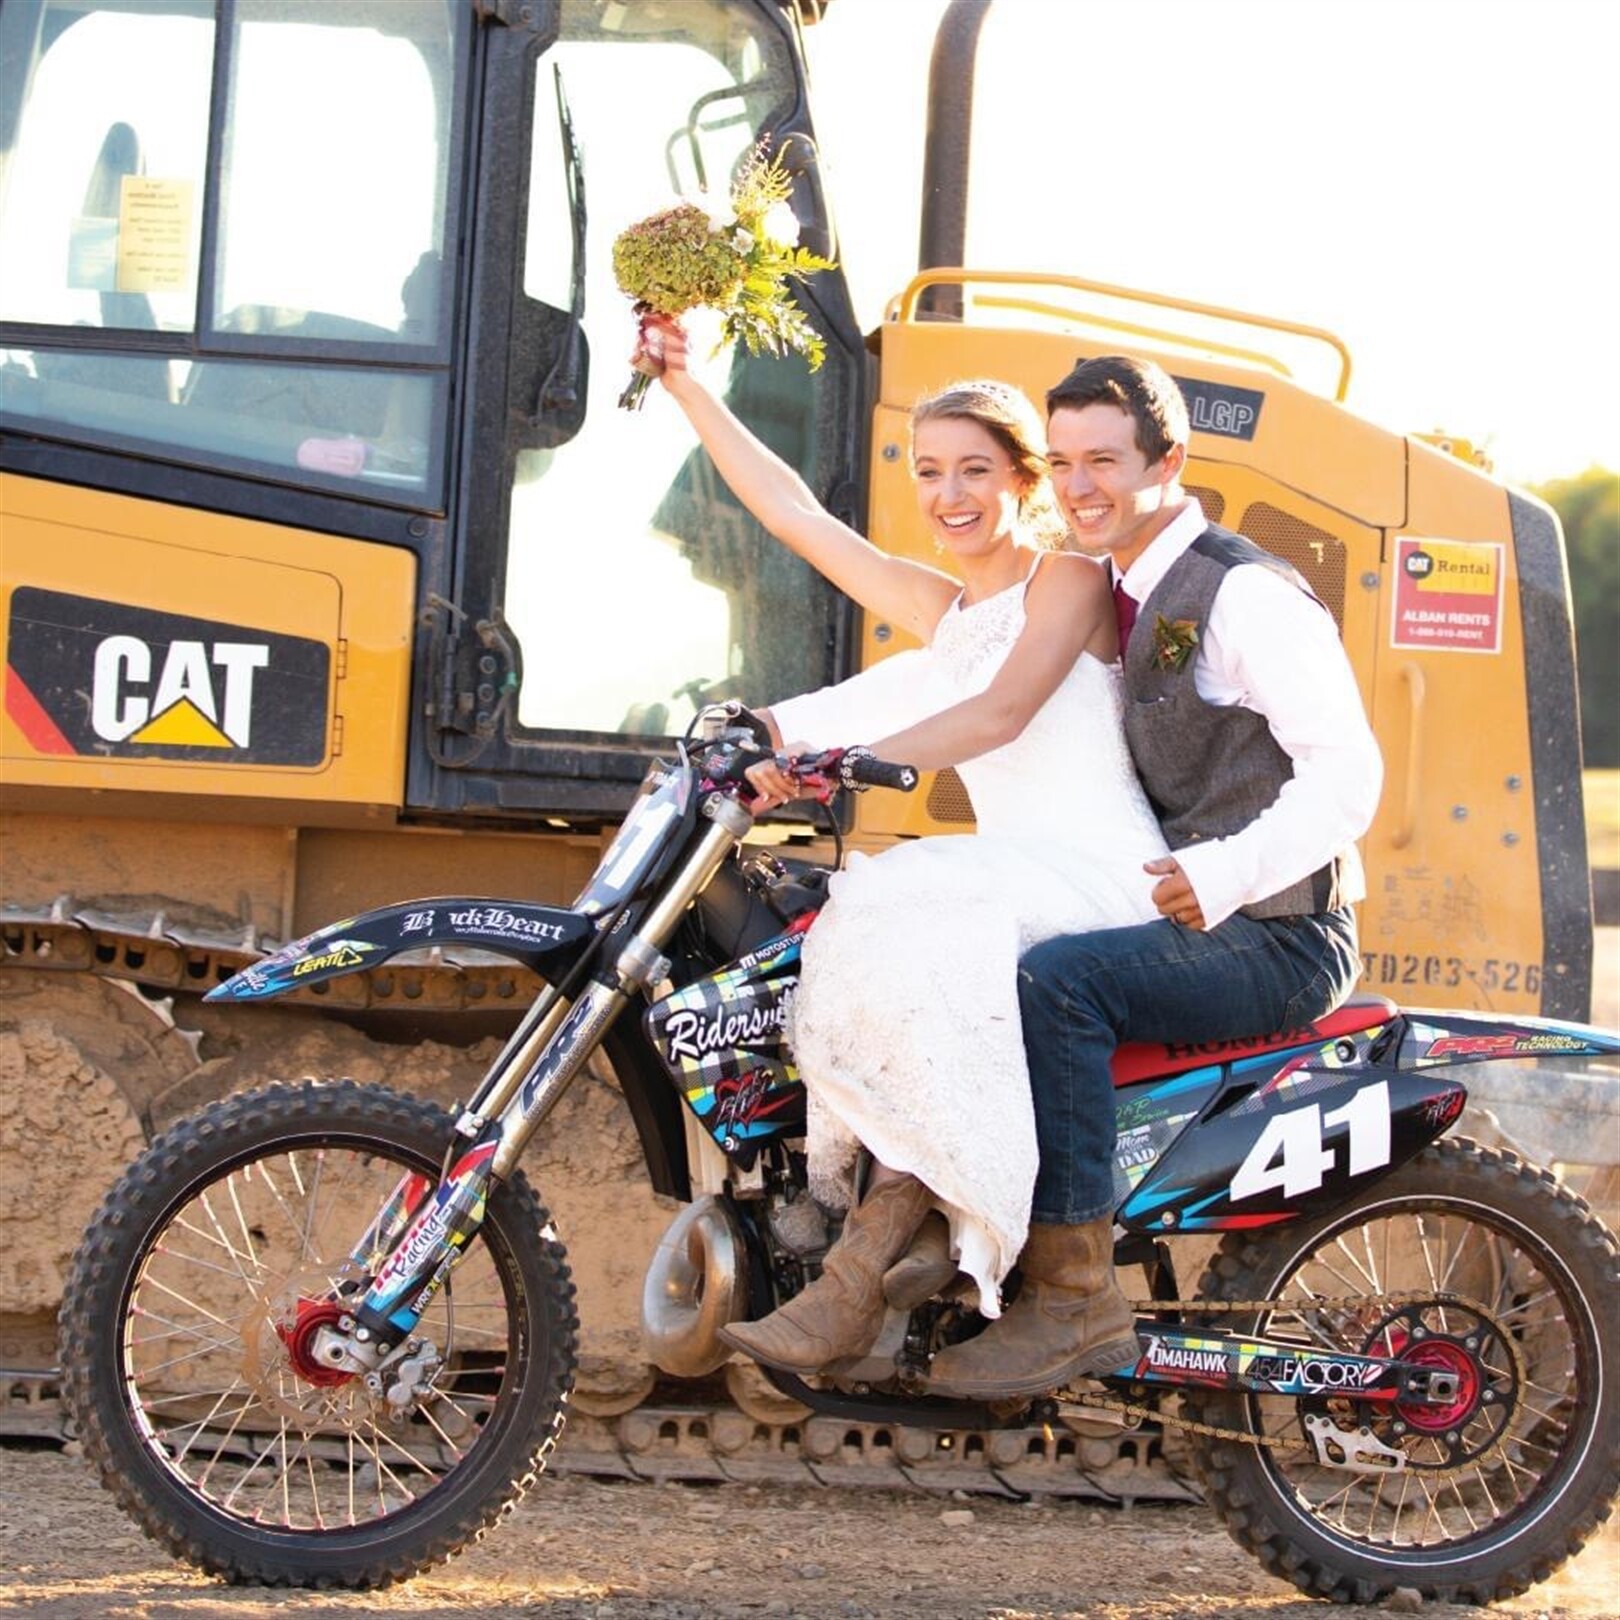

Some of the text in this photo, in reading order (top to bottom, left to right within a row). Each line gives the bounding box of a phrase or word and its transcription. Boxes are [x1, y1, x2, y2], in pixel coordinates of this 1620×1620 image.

[1193, 397, 1254, 433] LGP
[1407, 557, 1490, 575] CAT Rental
[1403, 609, 1491, 627] ALBAN RENTS
[92, 635, 270, 749] CAT
[1362, 953, 1541, 995] TD203-526
[1515, 1040, 1591, 1051] TECHNOLOGY
[1230, 1080, 1391, 1202] 41
[391, 1212, 447, 1277] Racing
